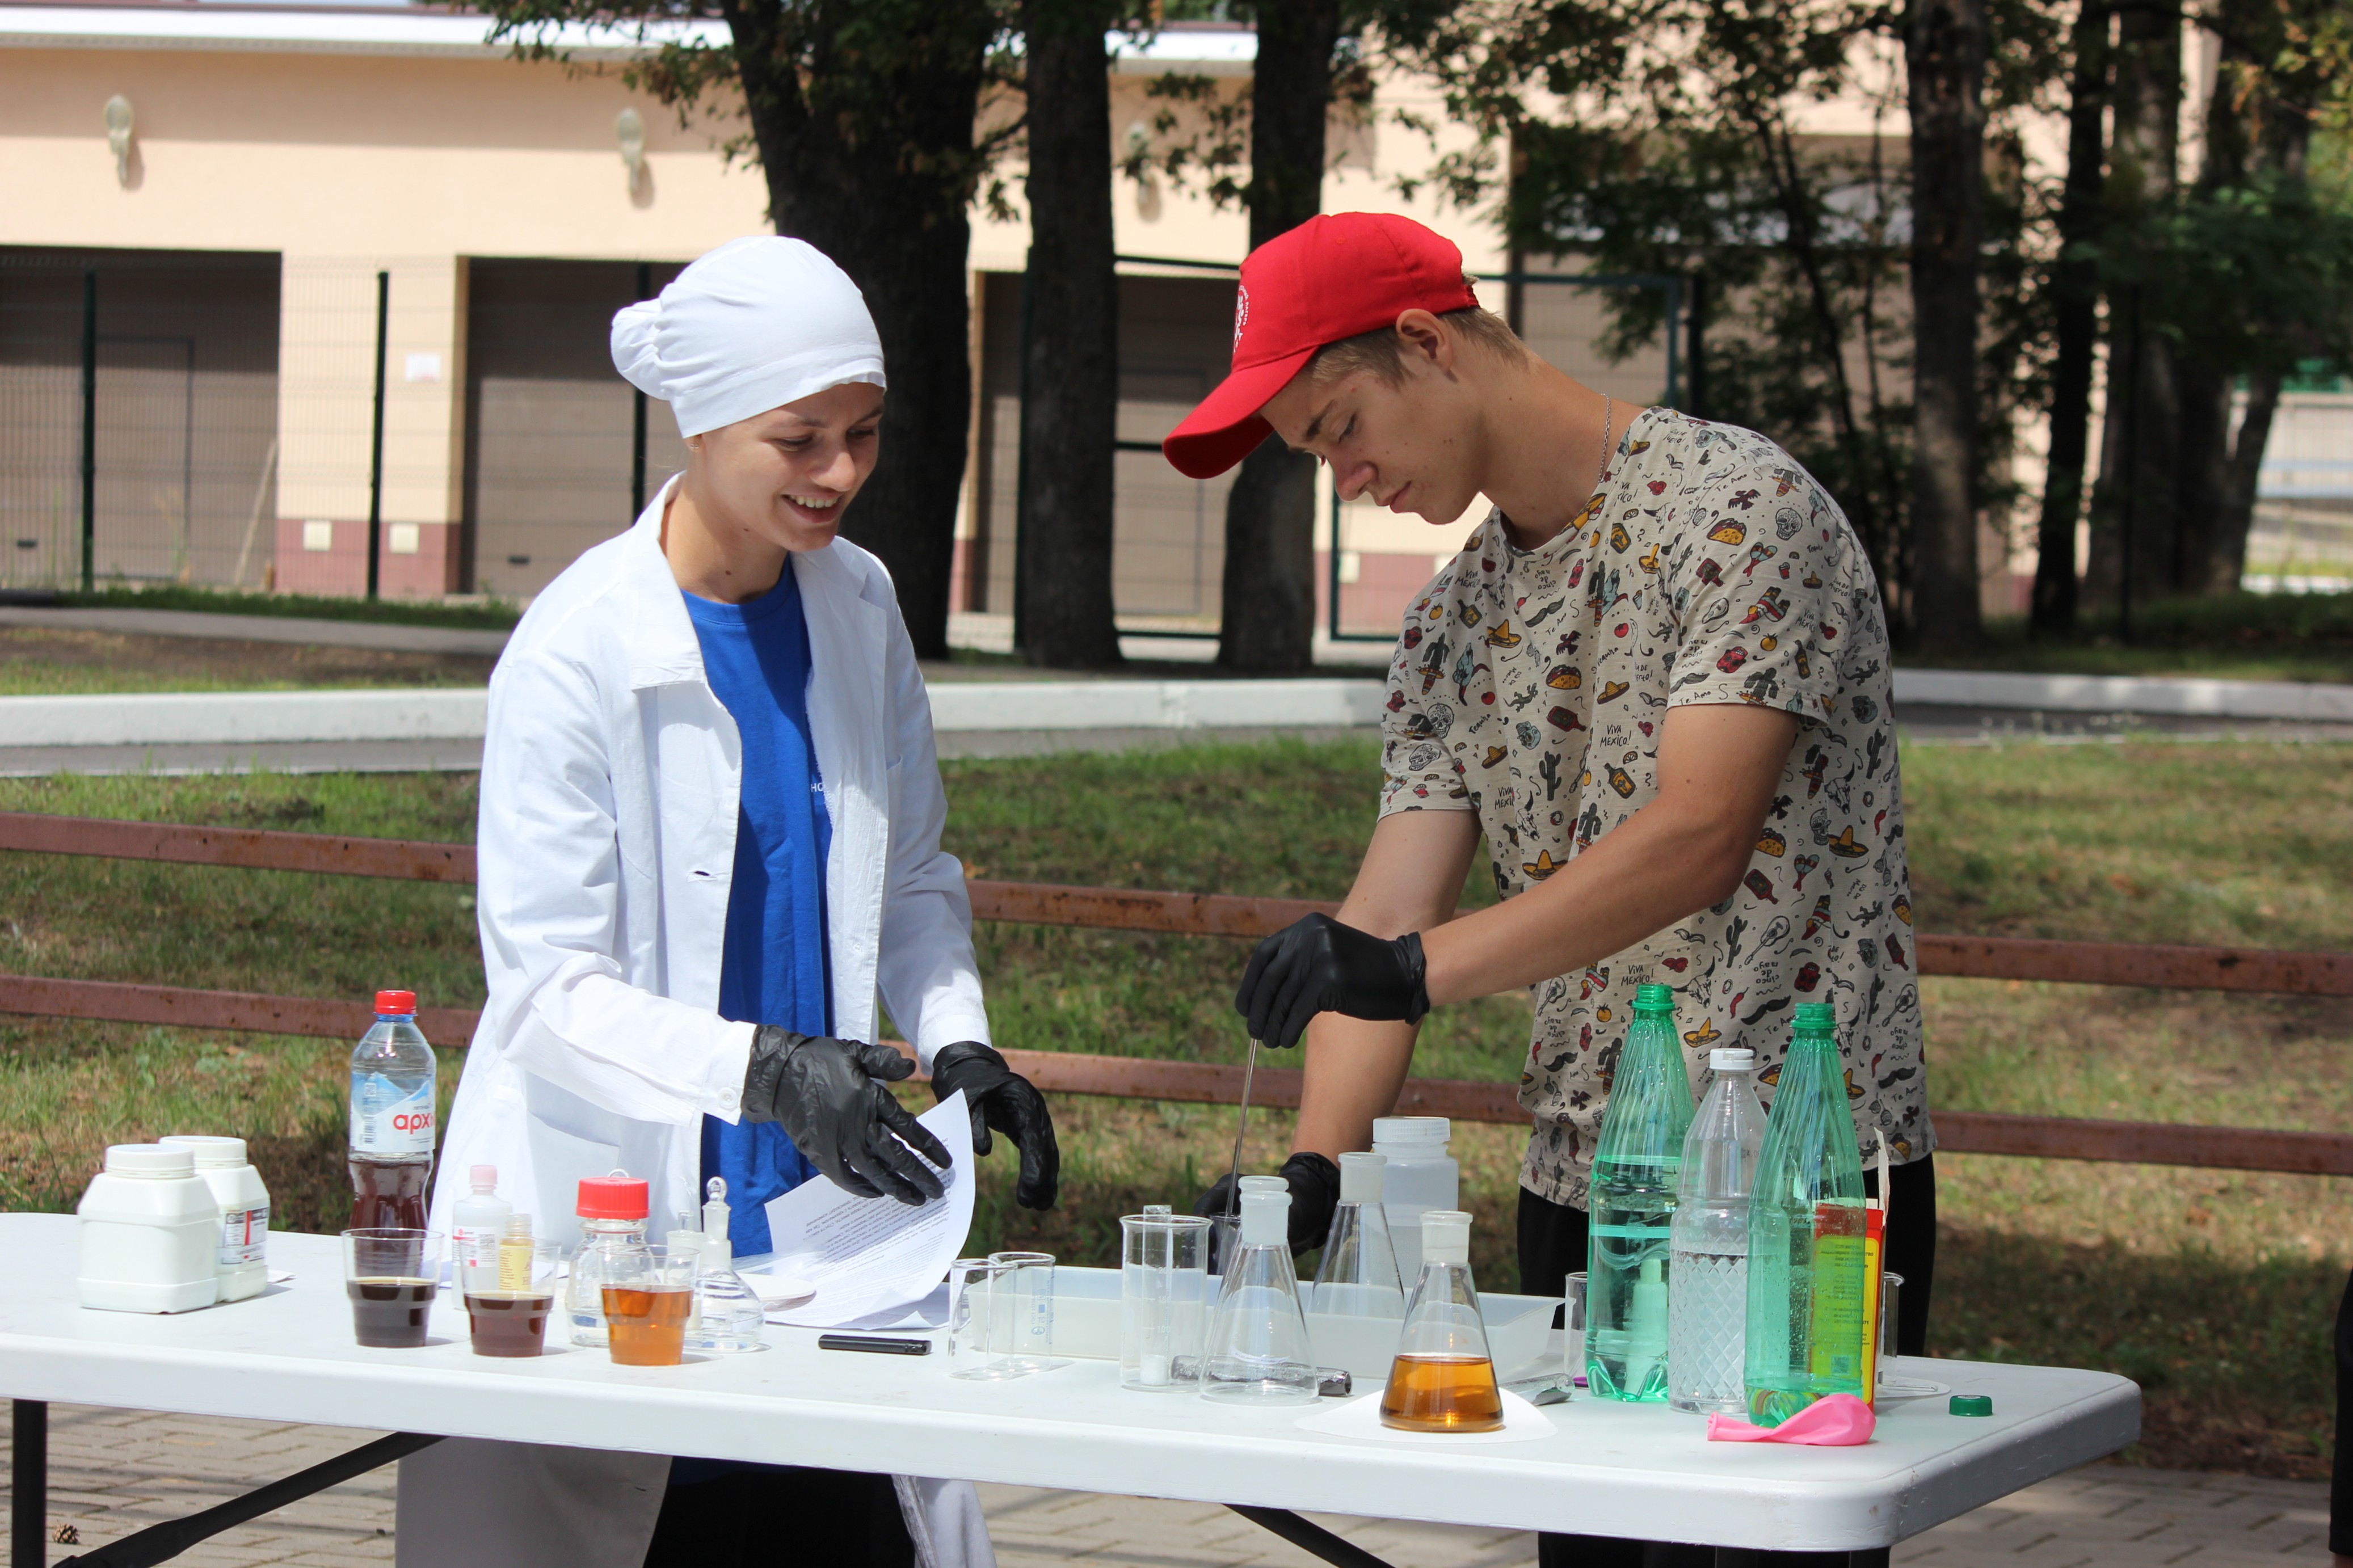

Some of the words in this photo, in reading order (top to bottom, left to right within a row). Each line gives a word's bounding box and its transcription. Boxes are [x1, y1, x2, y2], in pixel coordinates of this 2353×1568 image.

[1731, 474, 1747, 484] Amo
[1538, 580, 1556, 589] cinco
[1546, 627, 1556, 636] Te
[1557, 613, 1567, 625] Amo
[1694, 691, 1711, 700] Amo
[1754, 961, 1778, 972] mayo
[1756, 974, 1780, 984] cinco
[1544, 1016, 1561, 1025] mayo
[1765, 1025, 1779, 1035] Te
[1891, 1026, 1908, 1036] mayo
[1892, 1093, 1904, 1102] Te
